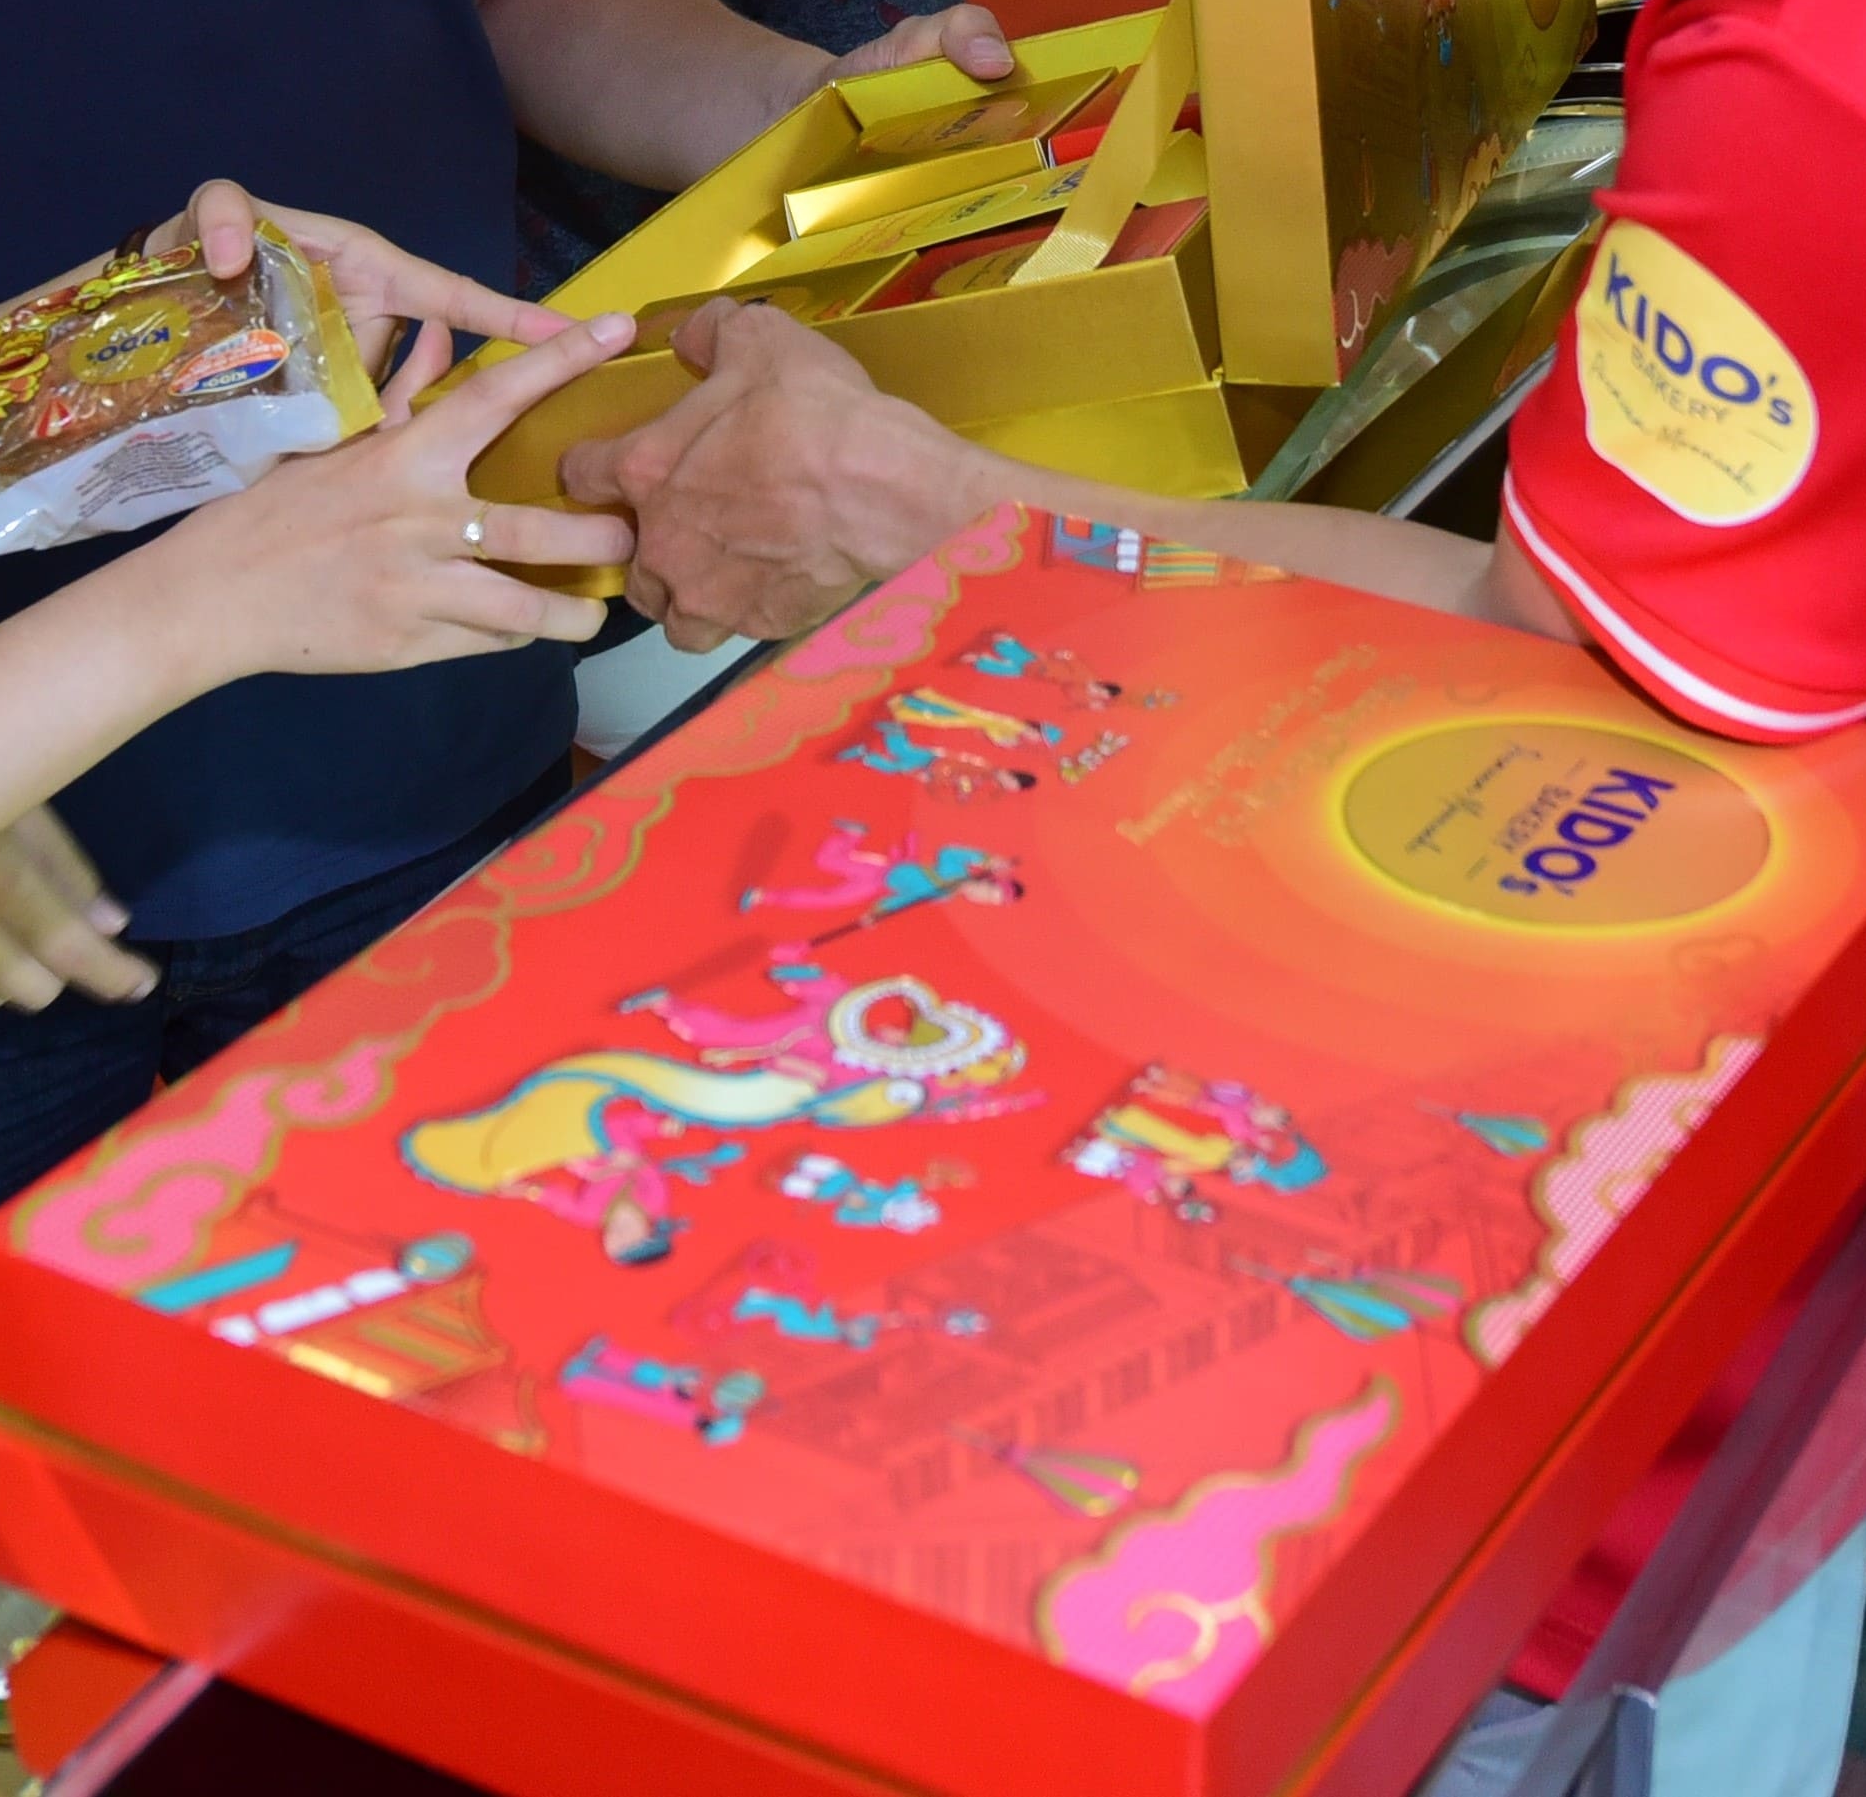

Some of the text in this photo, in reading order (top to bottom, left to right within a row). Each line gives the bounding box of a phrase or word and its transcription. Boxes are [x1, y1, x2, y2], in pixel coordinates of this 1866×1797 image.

[1605, 251, 1793, 427] KIDO's
[1630, 343, 1732, 424] BAKERY
[1498, 766, 1676, 897] KIDO's
